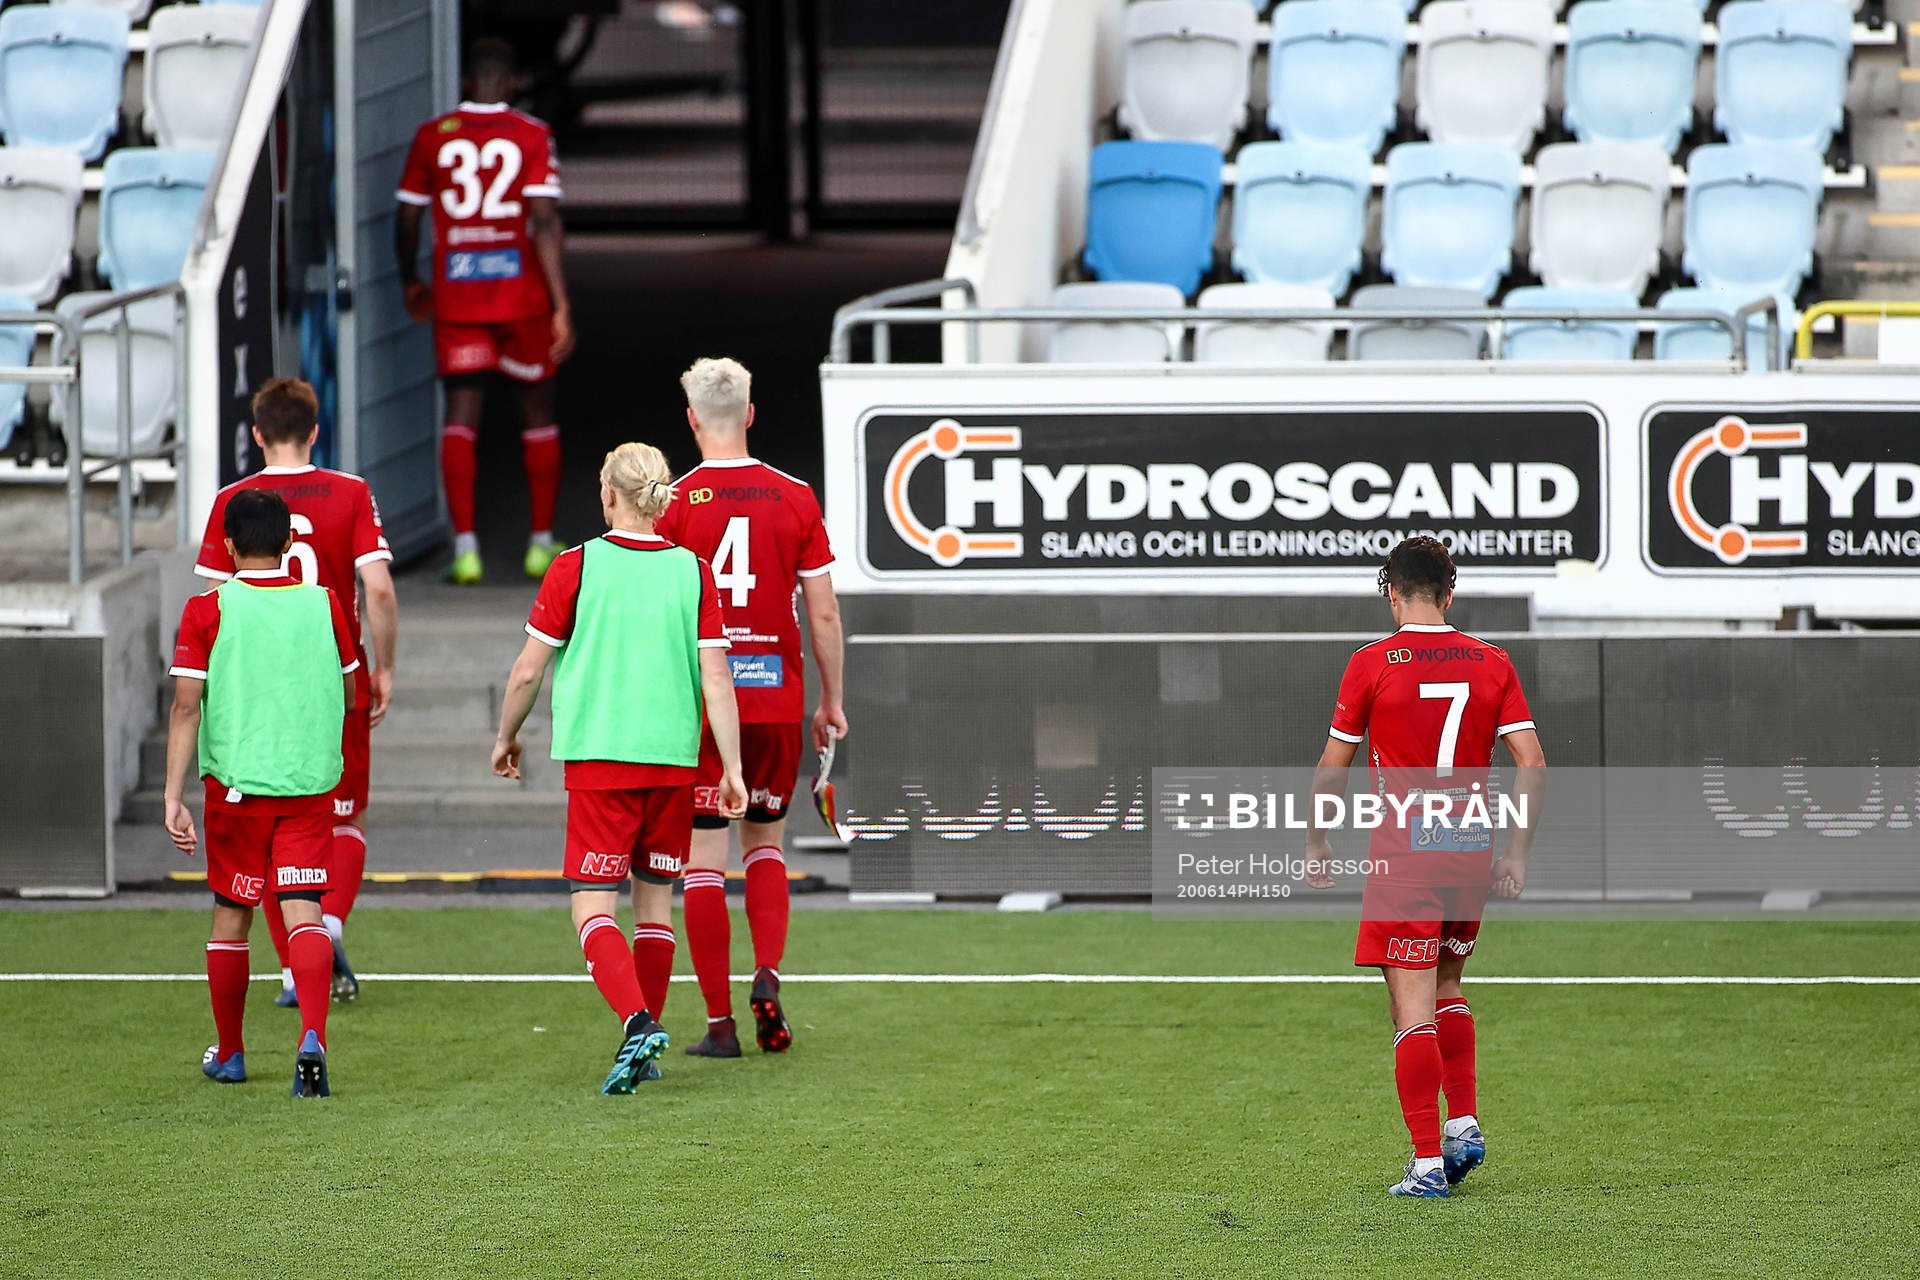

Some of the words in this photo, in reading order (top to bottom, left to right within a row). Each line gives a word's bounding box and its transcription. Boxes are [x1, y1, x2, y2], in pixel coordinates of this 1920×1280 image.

[437, 138, 522, 219] 32
[689, 488, 714, 505] BD
[716, 486, 782, 501] WORKS
[945, 459, 1580, 527] HYDROSCAND
[1041, 531, 1137, 558] SLANG
[1142, 531, 1206, 557] OCH
[1213, 529, 1573, 557] LEDNINGSKOONENTER
[711, 516, 757, 607] 4
[1386, 648, 1413, 664] BD
[1415, 647, 1485, 662] WORKS
[1419, 682, 1470, 778] 7
[277, 868, 327, 886] KURIREN
[1387, 937, 1439, 962] NSD
